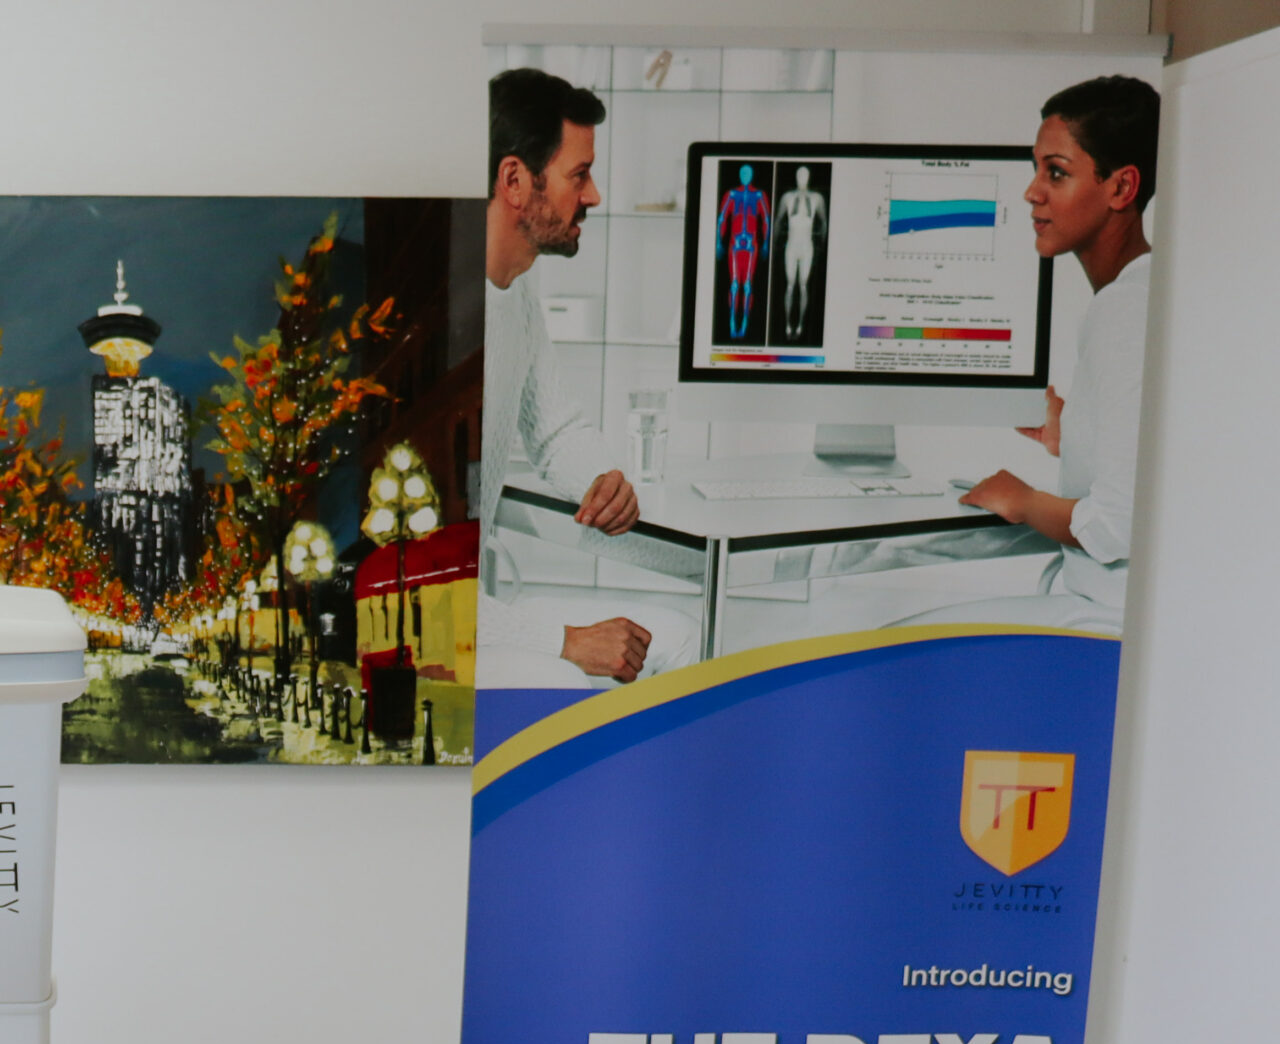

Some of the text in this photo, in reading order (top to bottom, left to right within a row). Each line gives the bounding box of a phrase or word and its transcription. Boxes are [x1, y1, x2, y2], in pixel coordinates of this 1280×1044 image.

[953, 883, 1063, 900] JEVITTY
[951, 902, 1062, 913] LIFE SCIENCE
[902, 963, 1074, 995] Introducing
